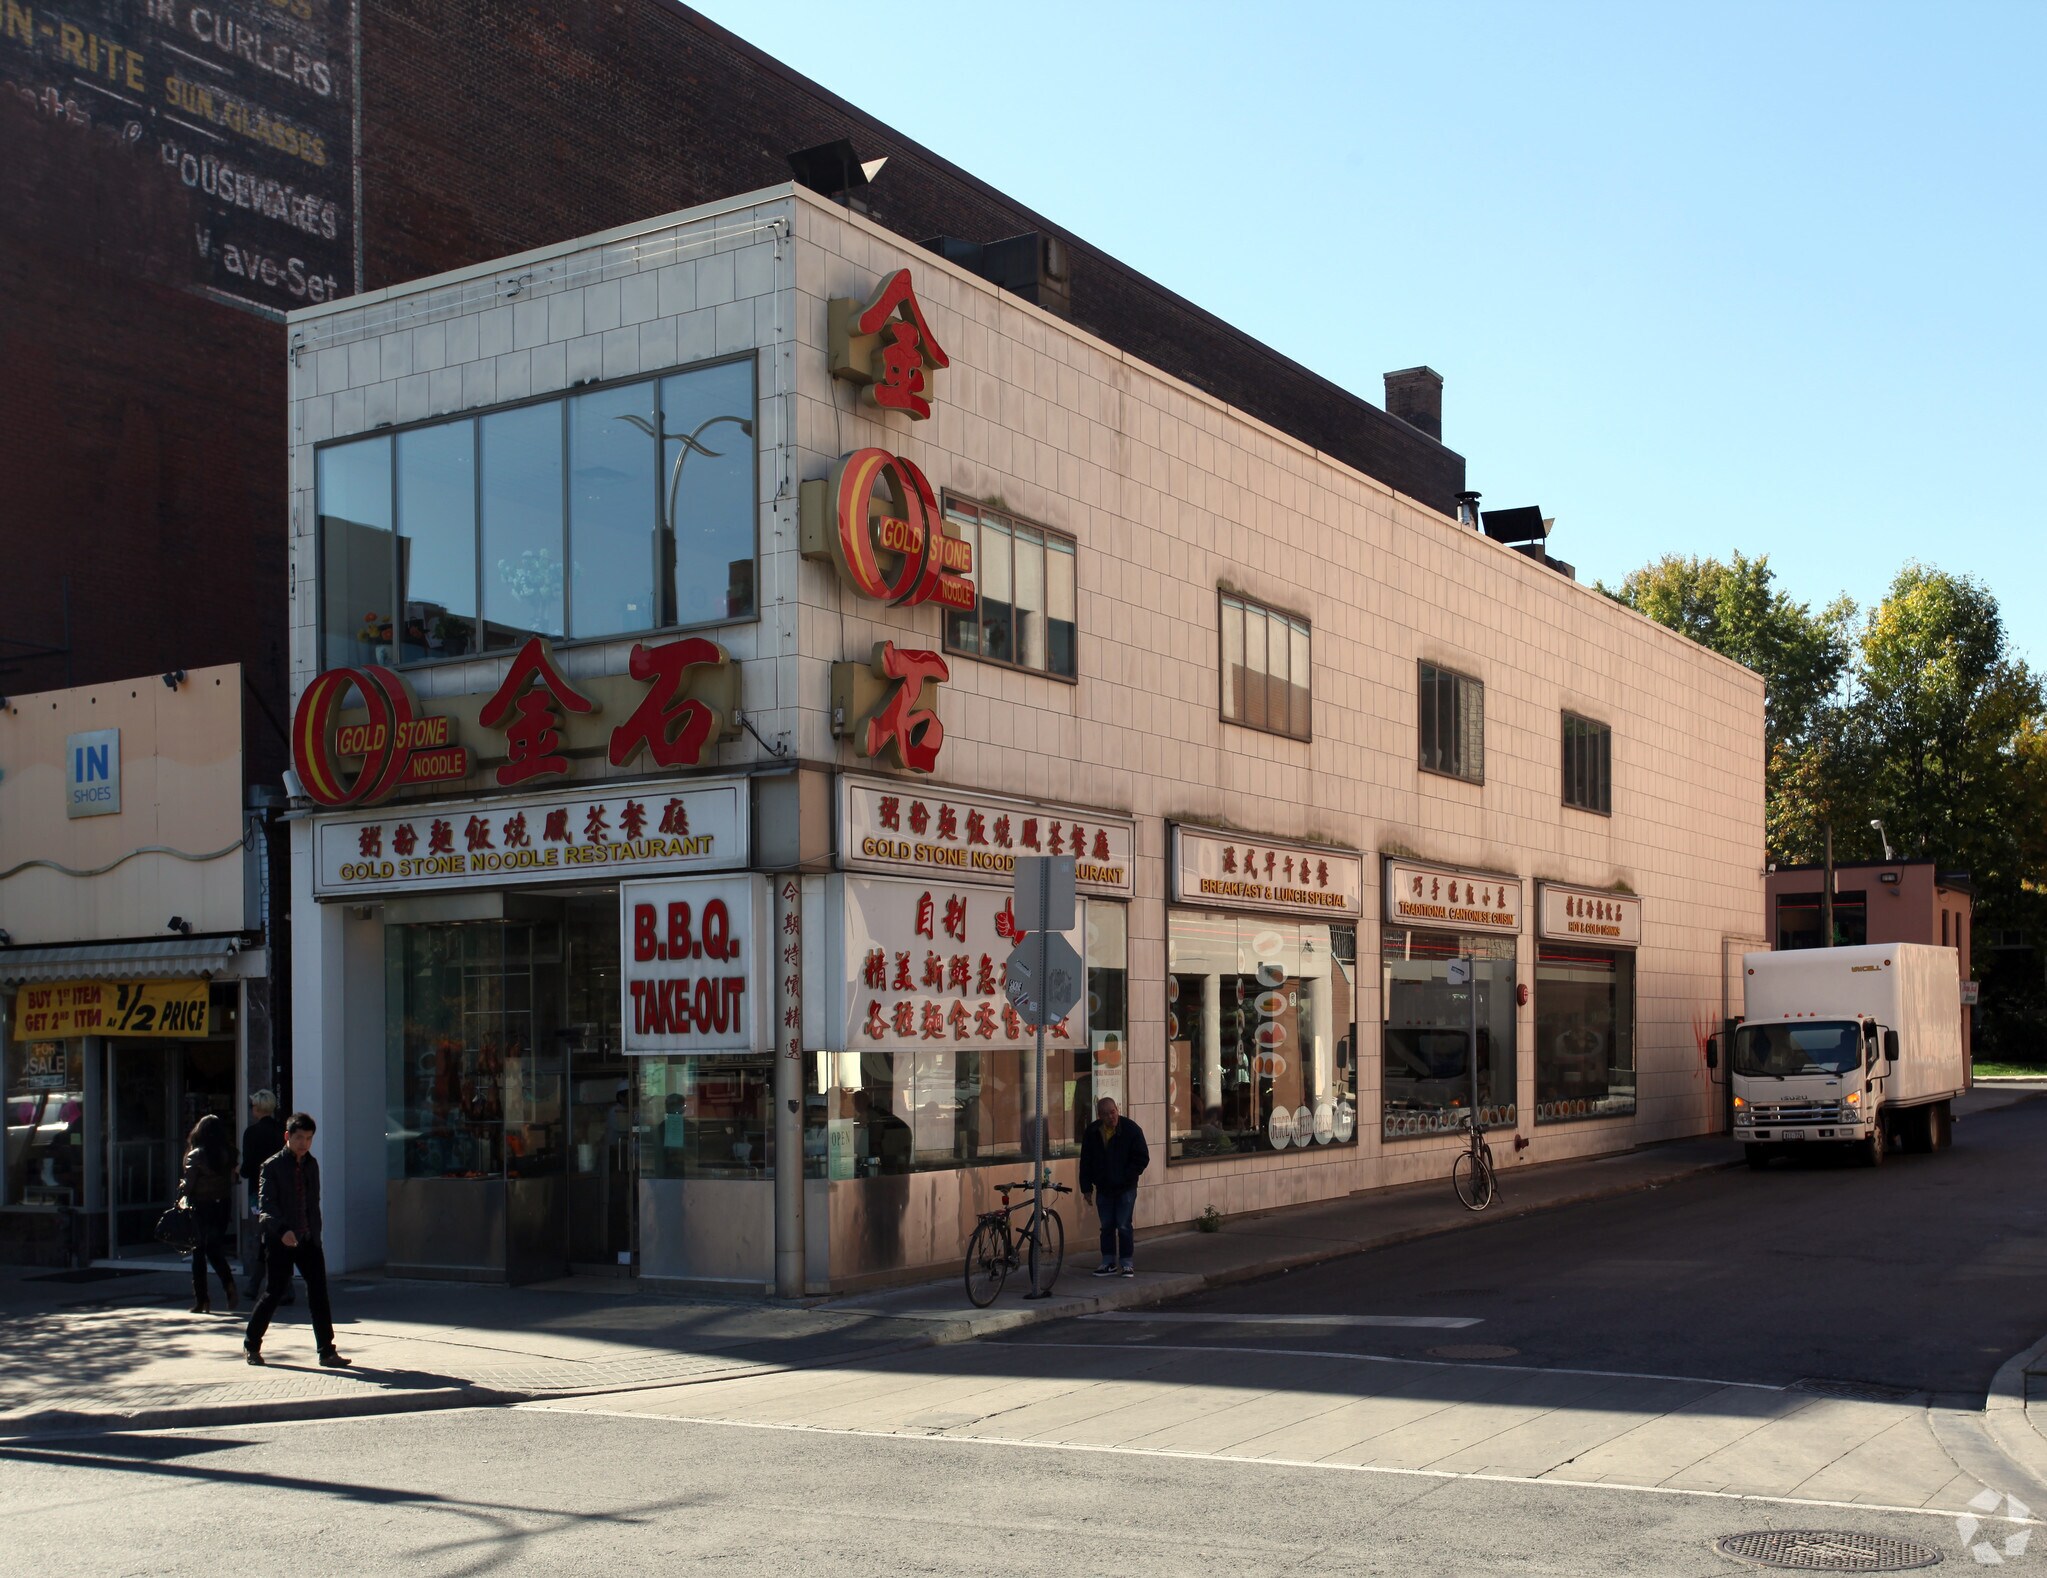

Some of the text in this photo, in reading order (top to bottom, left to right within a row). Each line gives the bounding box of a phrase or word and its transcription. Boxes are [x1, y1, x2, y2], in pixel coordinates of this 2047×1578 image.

[0, 2, 145, 92] N-RITE
[859, 268, 949, 419] 金
[882, 520, 970, 570] GOLD STONE
[942, 579, 970, 606] NOODLE
[479, 637, 725, 786] 金石
[867, 640, 949, 773] 石
[340, 717, 448, 754] GOLD STONE
[75, 744, 108, 783] IN
[413, 753, 463, 777] NOODLE
[74, 786, 111, 803] SHOES
[339, 835, 714, 881] GOLD STONE NOODLE RESTAURANT
[863, 836, 911, 860] GOLD
[915, 844, 968, 867] STONE
[971, 851, 1014, 872] NOOD
[1200, 878, 1346, 908] BREAKFAST & LUNCH SPECIAL
[1398, 900, 1447, 919] TRADITIONAL
[1449, 907, 1491, 924] CANTONESE
[1568, 921, 1580, 932] HOT
[1585, 923, 1600, 935] COLD
[634, 899, 739, 963] B.B.Q.
[782, 881, 800, 1060] 今期特價精選
[863, 948, 1007, 997] 精美新鮮急
[28, 991, 51, 1009] BUY
[72, 985, 102, 1004] ITEM
[630, 977, 745, 1035] TAKE-OUT
[25, 1012, 48, 1032] GET
[158, 1000, 206, 1031] PRICE
[29, 1055, 65, 1074] SALE
[32, 1042, 56, 1055] FOR
[831, 1129, 850, 1146] OPEN
